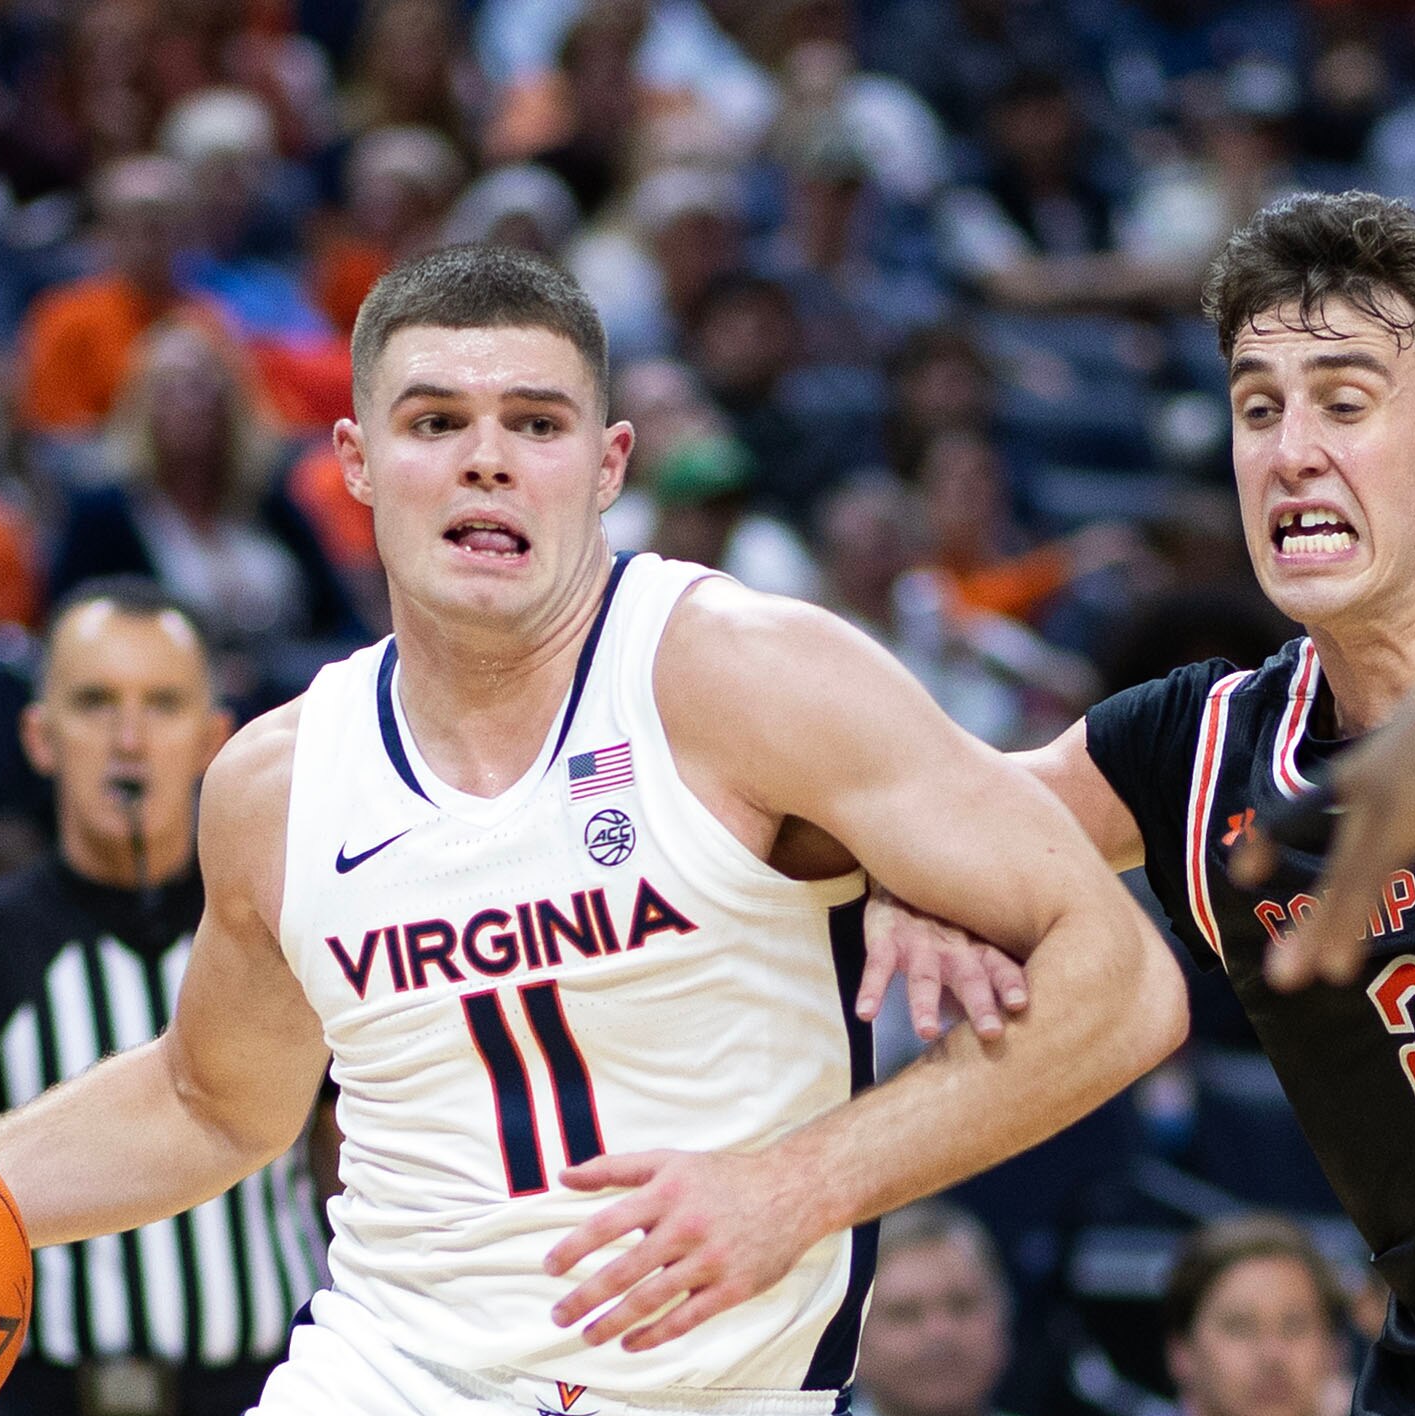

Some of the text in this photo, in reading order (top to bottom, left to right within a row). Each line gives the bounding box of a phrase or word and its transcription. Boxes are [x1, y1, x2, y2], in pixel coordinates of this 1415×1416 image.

[592, 824, 631, 843] ACC
[325, 876, 700, 1000] VIRGINIA
[460, 978, 606, 1199] 11
